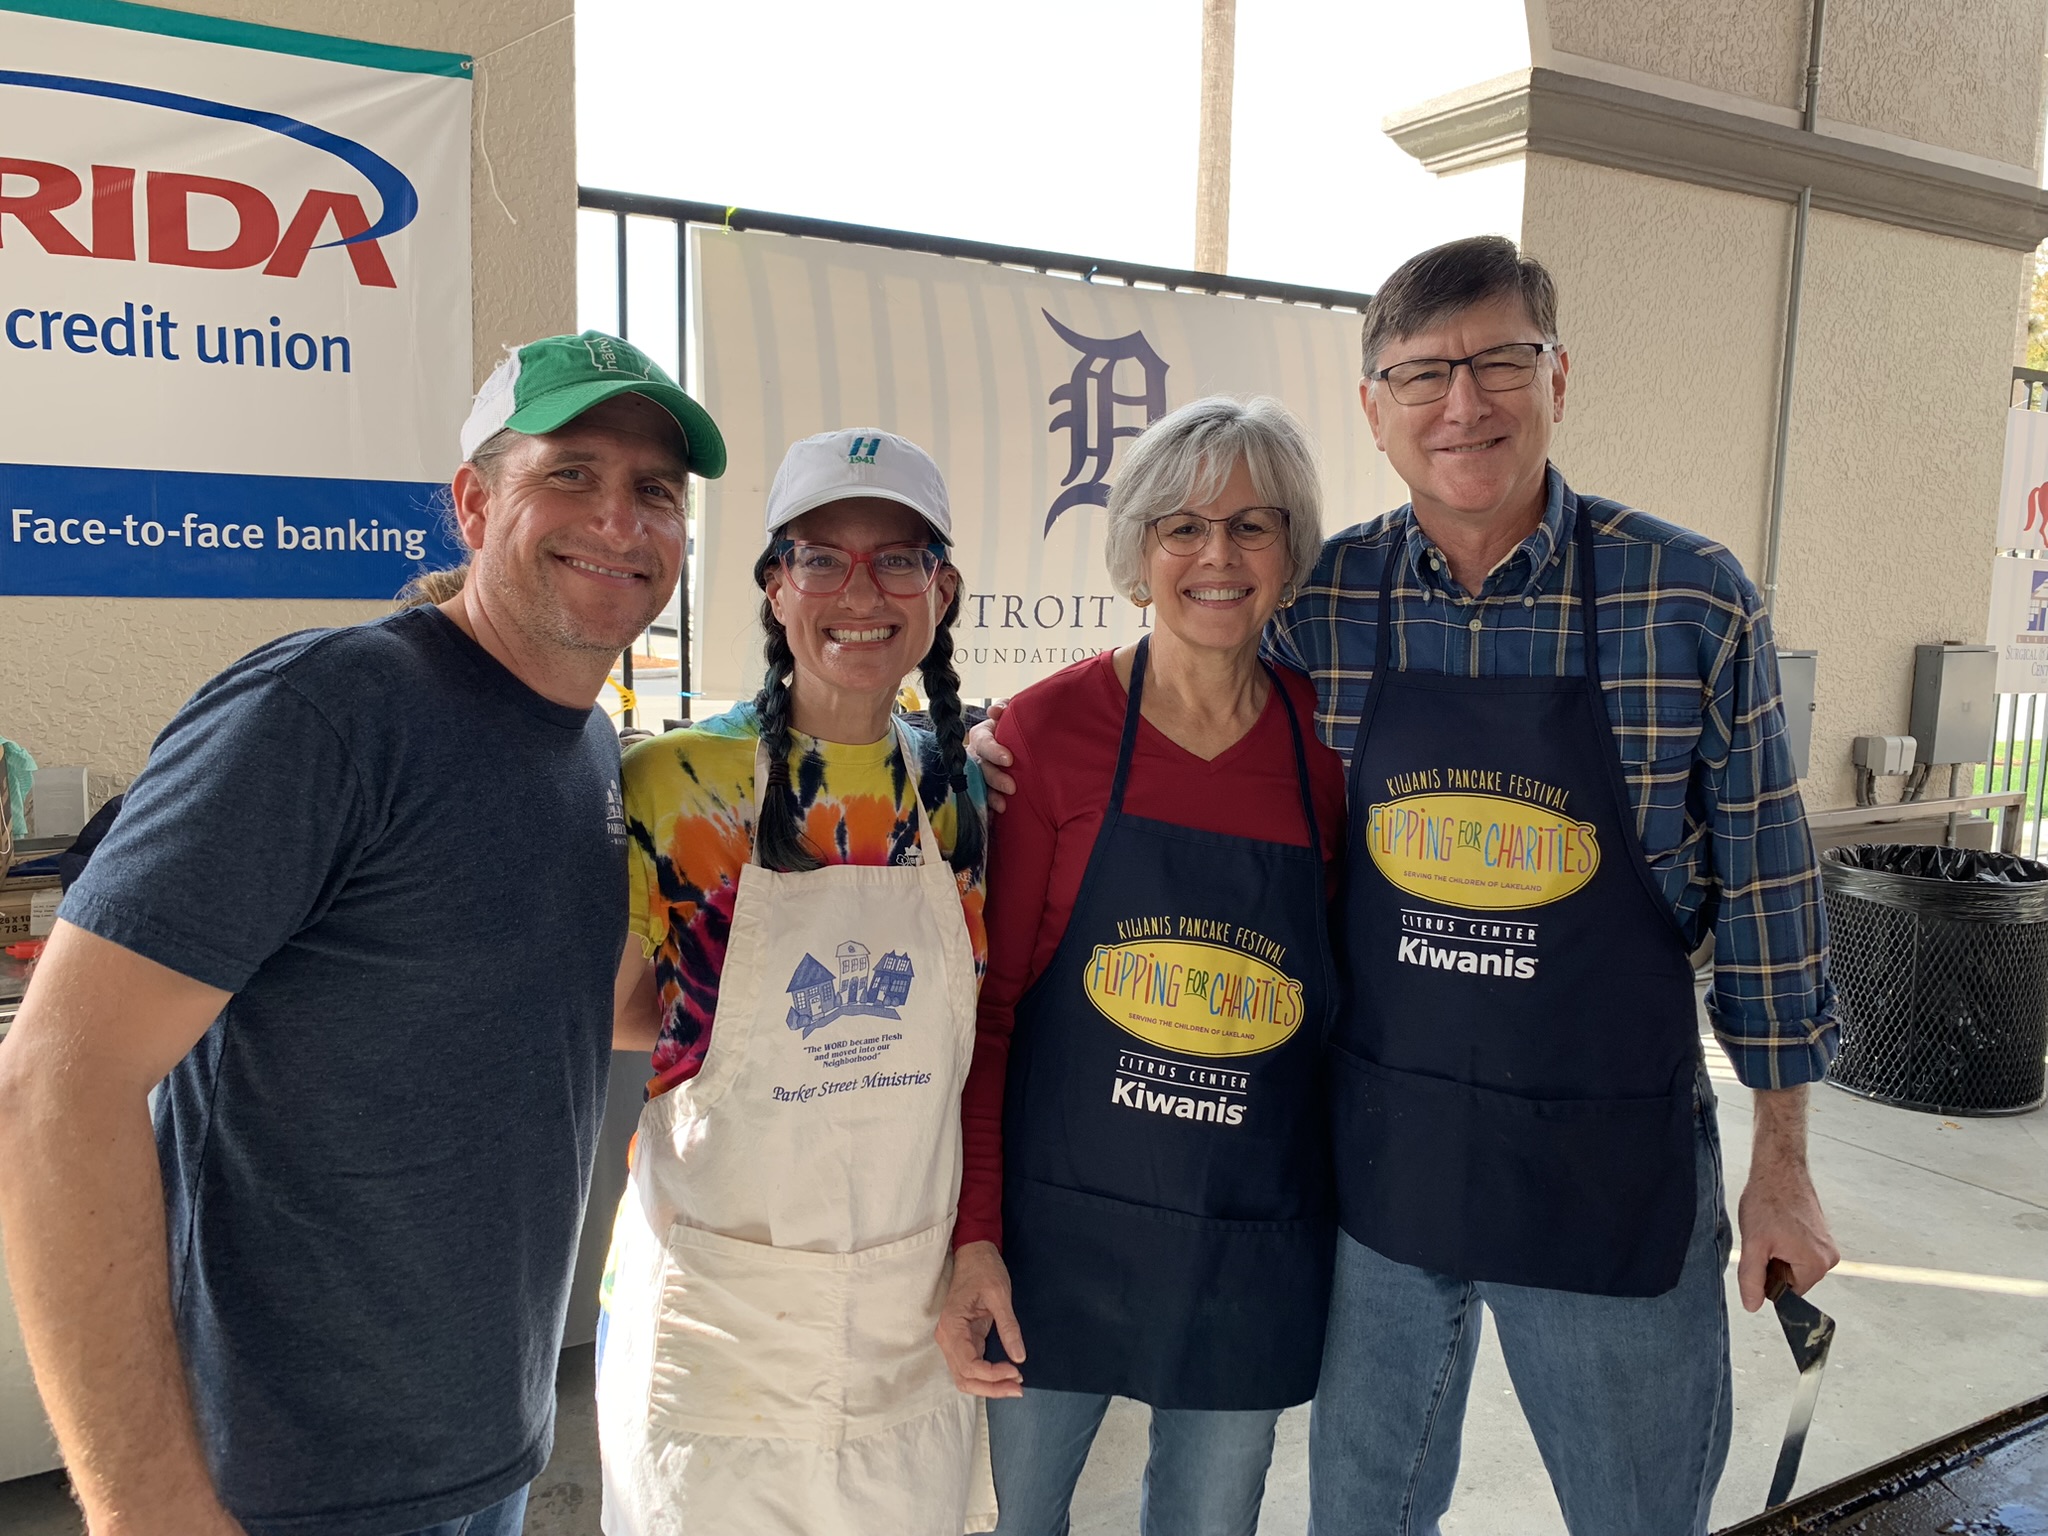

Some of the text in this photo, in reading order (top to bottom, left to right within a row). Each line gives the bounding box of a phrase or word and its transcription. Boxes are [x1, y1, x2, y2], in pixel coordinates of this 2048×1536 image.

[5, 301, 351, 373] credit union
[848, 456, 876, 465] 1941
[11, 508, 428, 561] Face-to-face banking
[955, 594, 1114, 629] TROIT
[1386, 769, 1570, 811] KIWANIS PANCAKE FESTIVAL
[1458, 820, 1482, 849] FOR
[1403, 870, 1433, 880] SERVING
[1434, 874, 1447, 882] THE
[1449, 876, 1486, 887] CHILDREN
[1500, 882, 1542, 892] LAKELAND
[1117, 916, 1287, 966] KIWANIS PANCAKE FESTIVAL
[1402, 914, 1536, 941] CITRUS CENTER
[1398, 935, 1536, 979] Kiwanis
[1185, 968, 1209, 998] FOR
[823, 1041, 848, 1051] WORD
[849, 1037, 880, 1047] became
[881, 1033, 903, 1042] Flesh
[1128, 1013, 1158, 1025] SERVING
[1159, 1019, 1173, 1027] THE
[1174, 1022, 1210, 1034] CHILDREN
[1221, 1030, 1255, 1040] LAKELAND
[814, 1043, 890, 1061] and moved into our
[772, 1070, 932, 1103] Parker Street Ministries
[1120, 1056, 1247, 1089] CITRUS CENTER
[1111, 1078, 1244, 1125] Kiwanis
